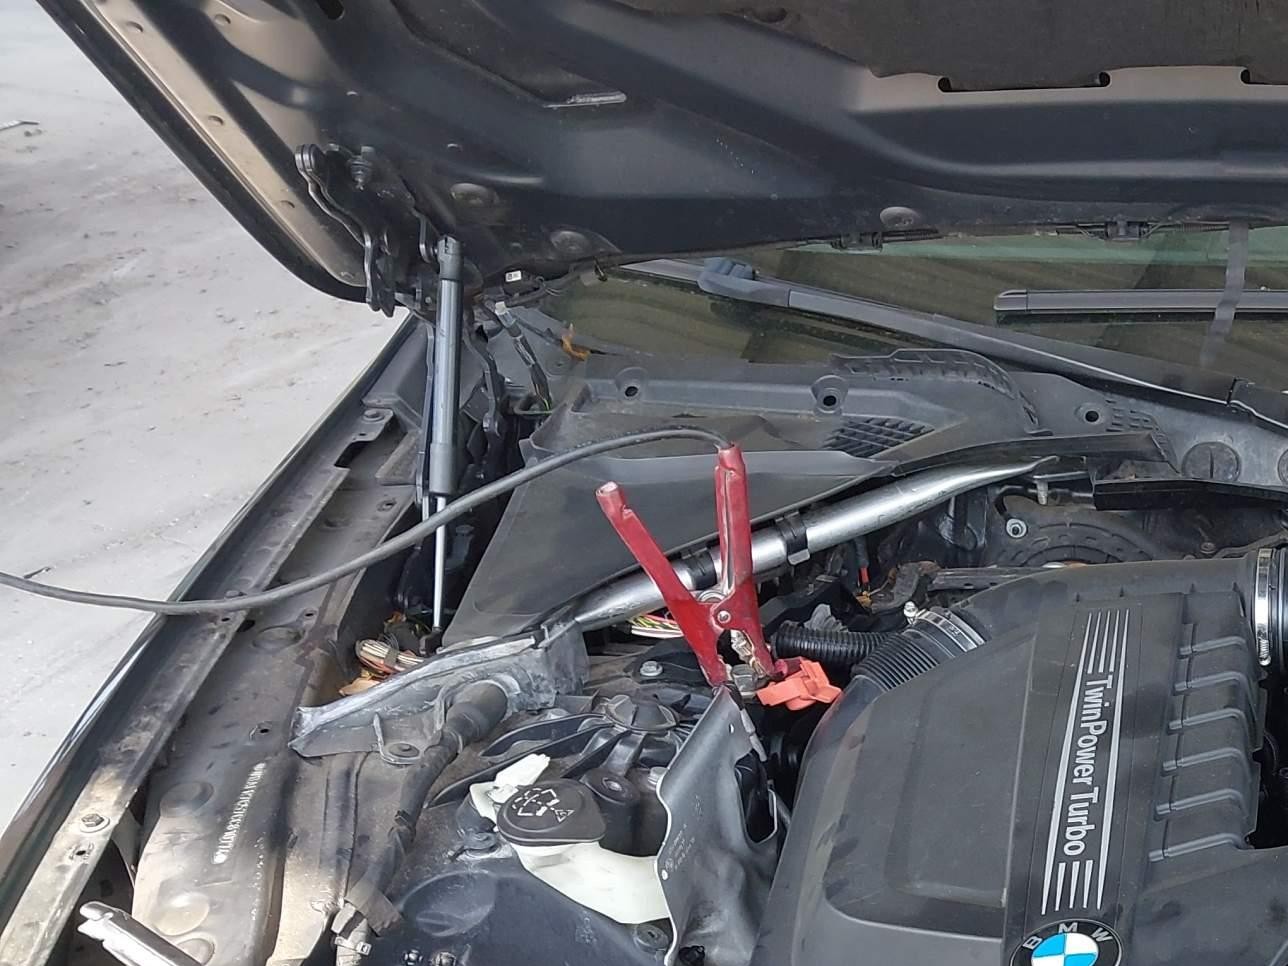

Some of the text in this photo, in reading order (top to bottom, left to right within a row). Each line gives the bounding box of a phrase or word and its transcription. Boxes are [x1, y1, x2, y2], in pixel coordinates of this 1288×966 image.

[1063, 674, 1113, 856] TwinPower Turbo
[1022, 922, 1113, 950] BMW
